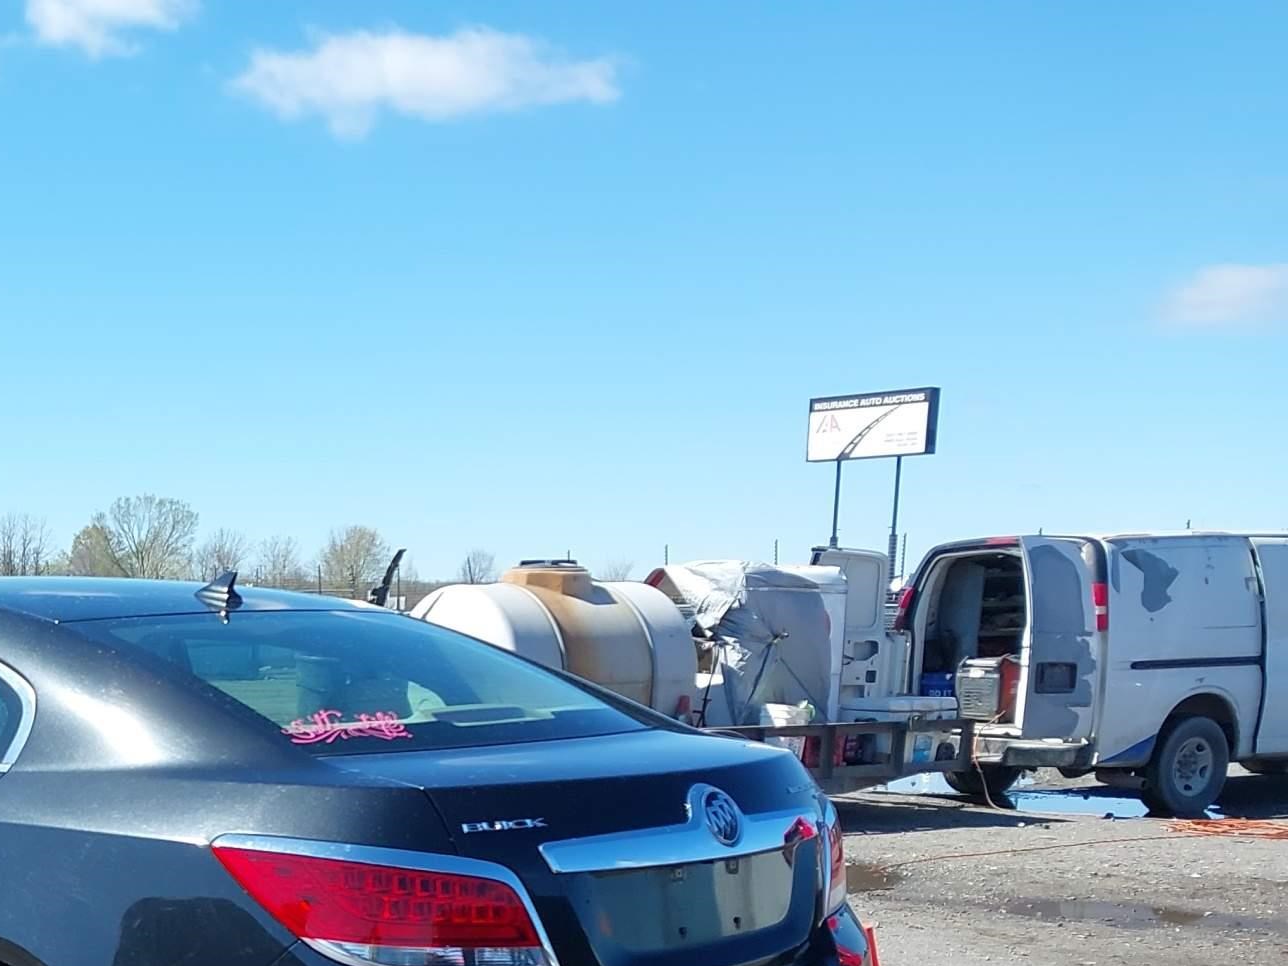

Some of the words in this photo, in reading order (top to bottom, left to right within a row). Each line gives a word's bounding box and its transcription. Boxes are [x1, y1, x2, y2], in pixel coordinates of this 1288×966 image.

[814, 399, 858, 411] INSURANCE
[860, 397, 882, 406] AUTO
[883, 393, 926, 405] AUCTIONS
[461, 817, 548, 834] BUICK
